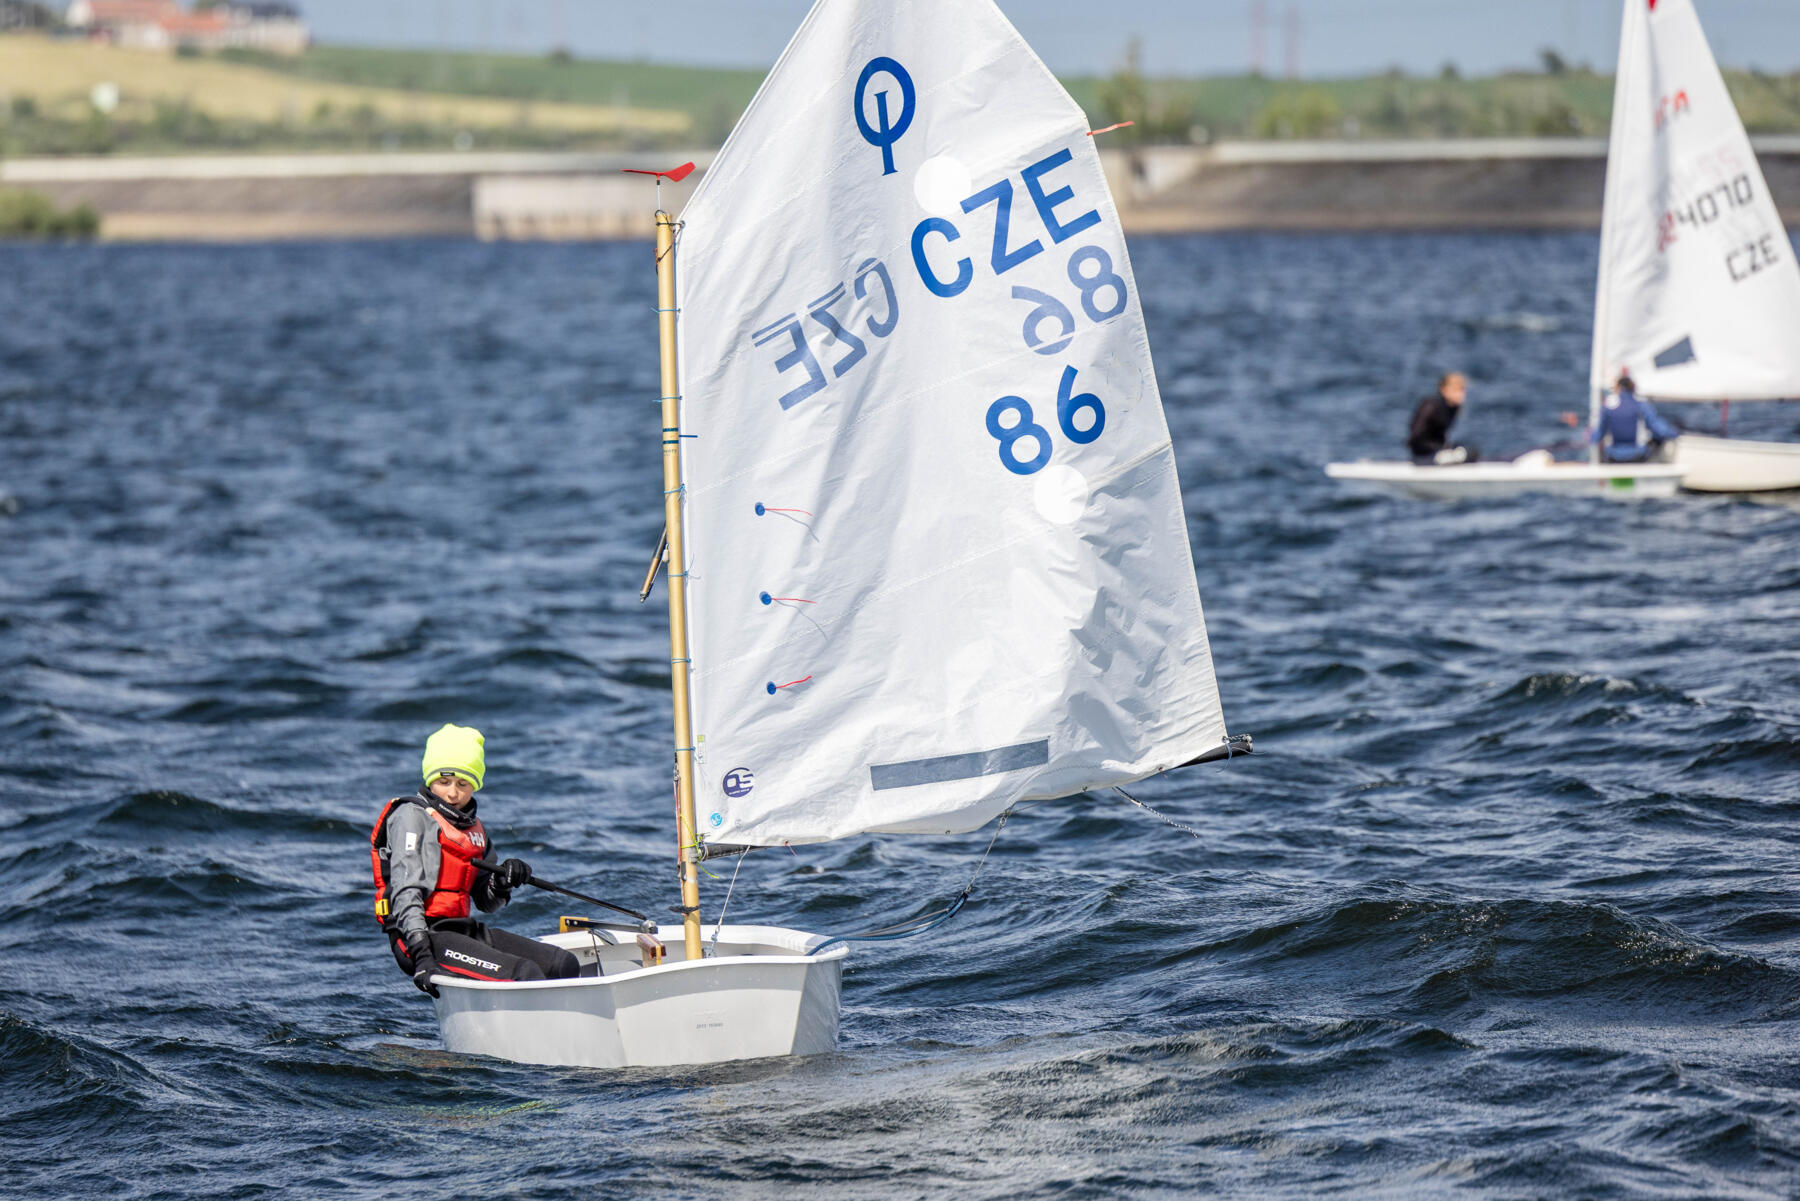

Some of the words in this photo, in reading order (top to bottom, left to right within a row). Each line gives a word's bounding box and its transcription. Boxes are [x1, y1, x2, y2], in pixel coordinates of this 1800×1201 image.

[911, 148, 1102, 298] CZE
[1726, 233, 1779, 283] CZE
[986, 365, 1106, 476] 86
[445, 949, 499, 972] ROOSTER
